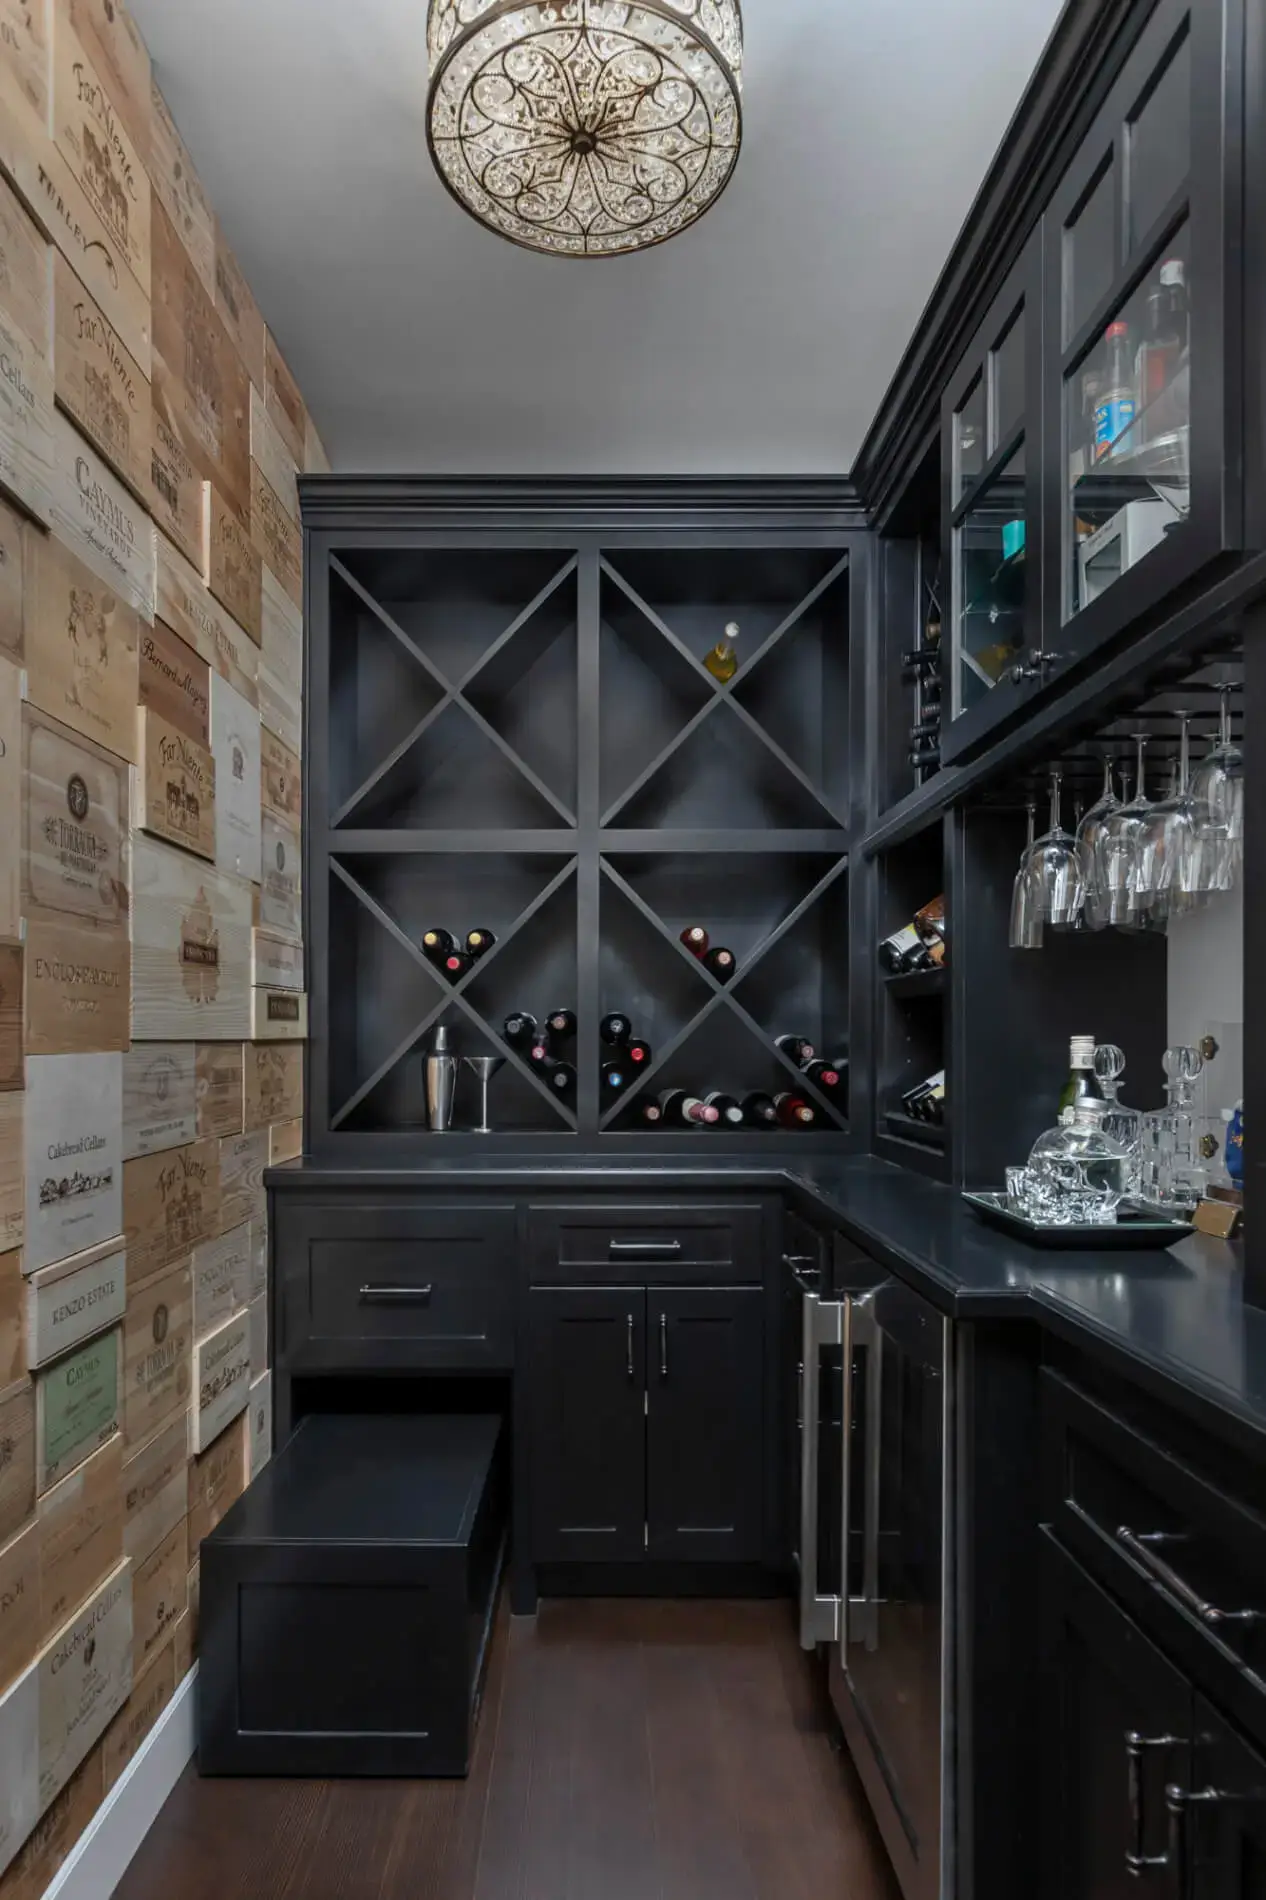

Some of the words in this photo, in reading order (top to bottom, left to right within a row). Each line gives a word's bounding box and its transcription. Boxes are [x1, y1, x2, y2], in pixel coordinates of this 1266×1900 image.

[72, 62, 97, 109] Far
[96, 85, 138, 202] Niente
[73, 302, 97, 342] Far
[96, 315, 139, 414] Niente
[75, 456, 136, 547] CAYMUS
[141, 637, 180, 689] Bernard
[158, 735, 177, 769] Far
[175, 735, 204, 783] Niente
[48, 1140, 84, 1161] Cakebread
[155, 1165, 178, 1204] Far
[52, 1294, 87, 1326] KENZO
[86, 1280, 117, 1309] ESTATE
[51, 1611, 97, 1676] Cakebread
